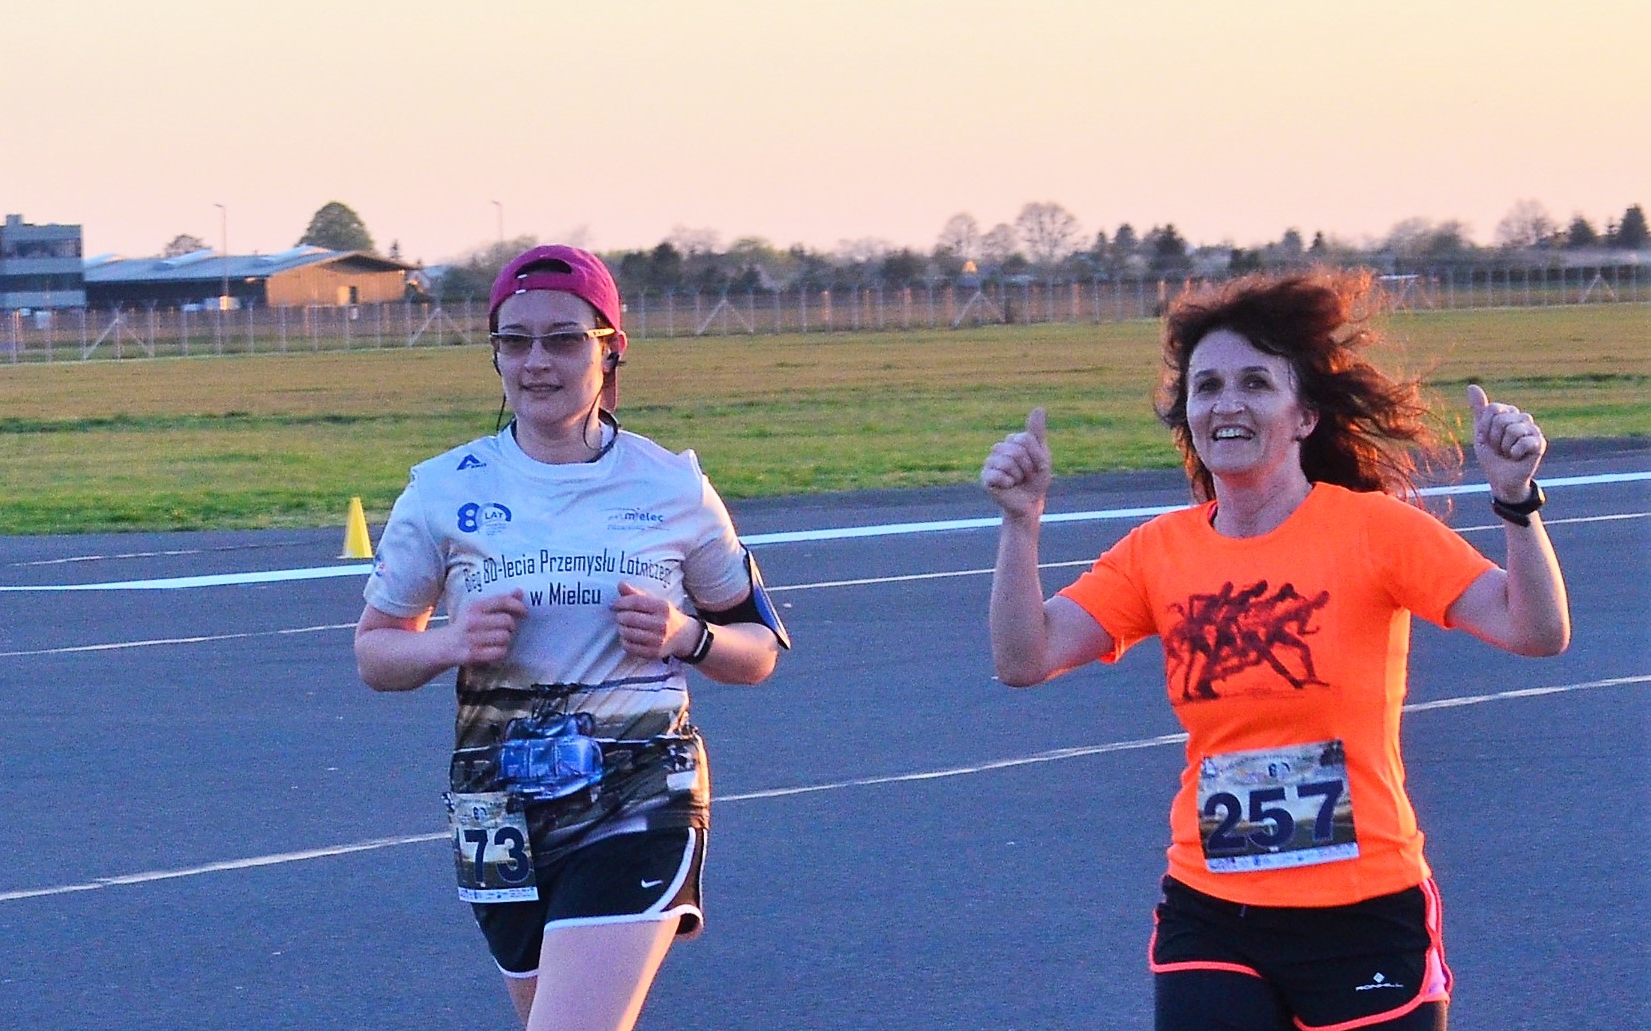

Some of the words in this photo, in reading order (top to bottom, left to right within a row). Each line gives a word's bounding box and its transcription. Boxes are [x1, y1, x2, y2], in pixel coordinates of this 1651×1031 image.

[484, 510, 505, 521] LAT
[482, 553, 536, 585] 80-lecia
[540, 548, 616, 577] Przemysłu
[529, 591, 543, 607] w
[549, 581, 602, 606] Mielcu
[1203, 778, 1345, 850] 257
